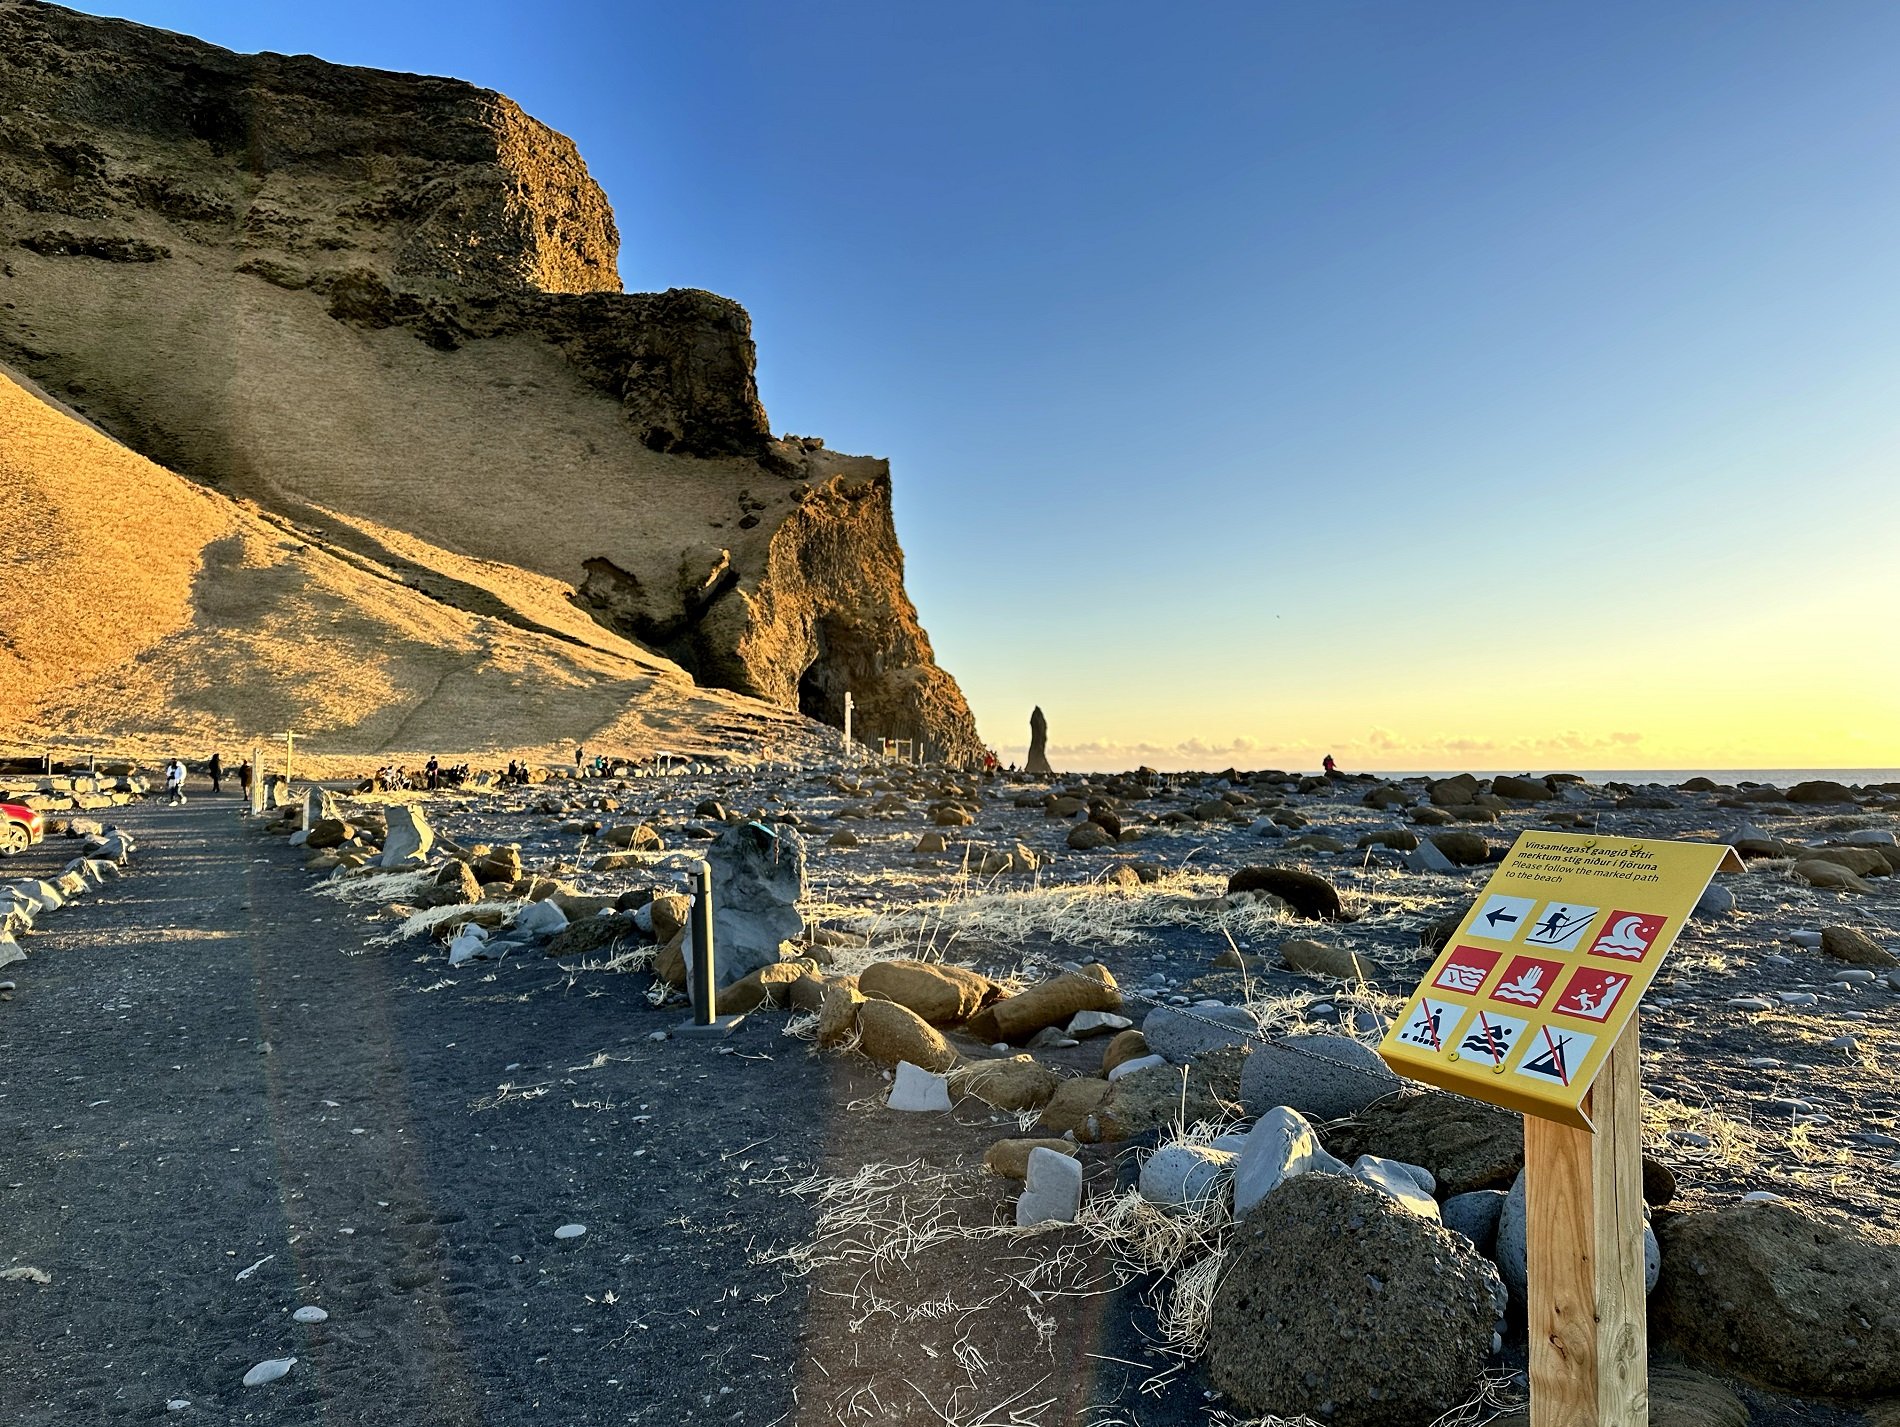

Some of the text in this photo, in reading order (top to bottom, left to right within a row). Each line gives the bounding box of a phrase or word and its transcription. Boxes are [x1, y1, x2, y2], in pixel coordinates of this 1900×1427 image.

[1525, 841, 1654, 859] Vinsamlegast gangið eftir
[1517, 852, 1561, 861] merktum
[1562, 855, 1583, 865] stig
[1583, 857, 1612, 866] niður
[1618, 860, 1658, 871] fjöruna
[1505, 870, 1563, 883] to the beach
[1511, 860, 1659, 882] Please follow the marked path
